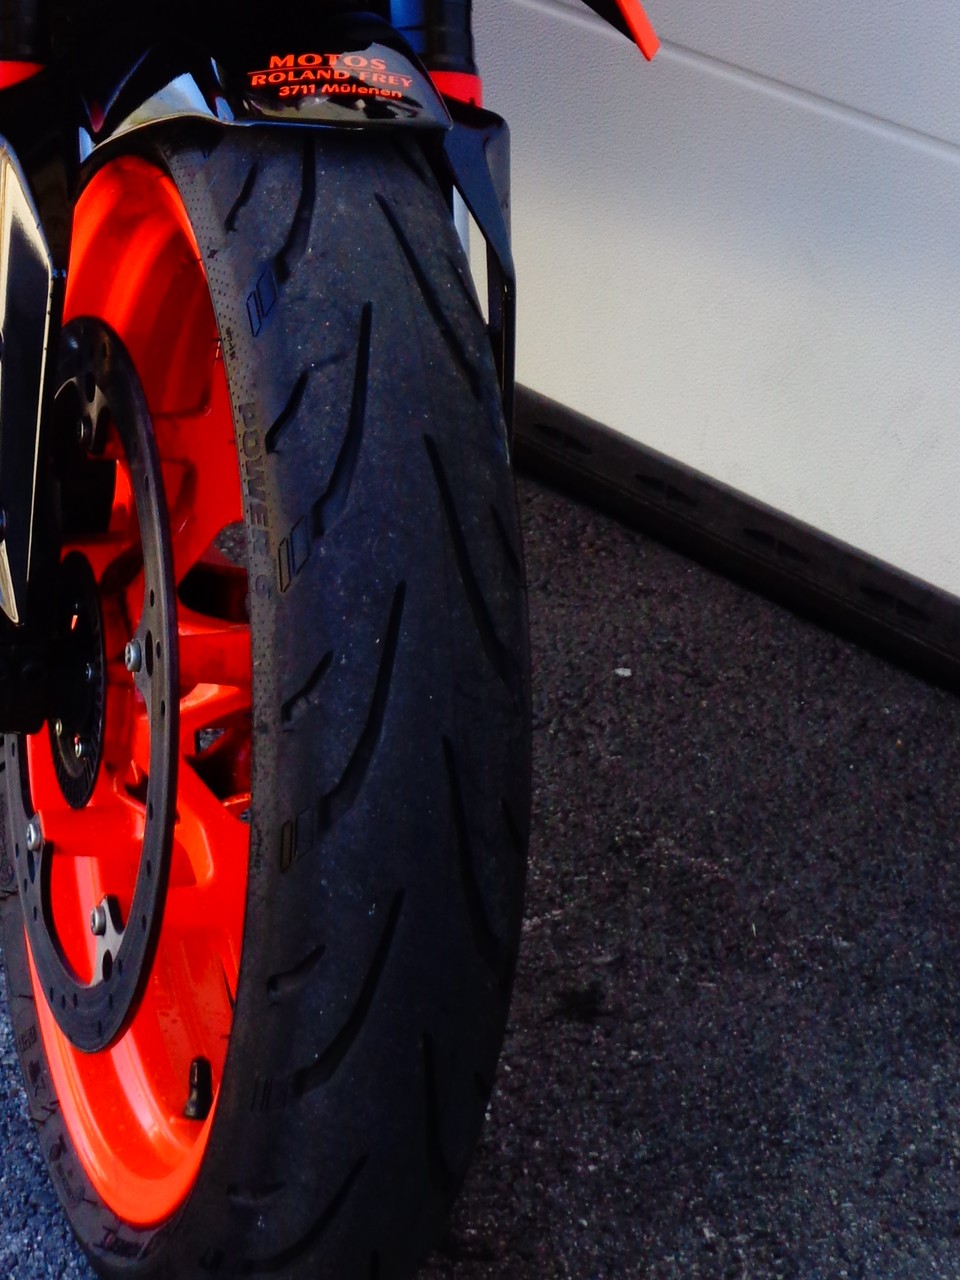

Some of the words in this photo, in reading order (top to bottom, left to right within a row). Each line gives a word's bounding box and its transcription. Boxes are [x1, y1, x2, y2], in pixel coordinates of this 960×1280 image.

[269, 53, 387, 70] MOTOS
[251, 69, 351, 86] ROLAND
[358, 71, 413, 88] FREY
[279, 84, 316, 96] 3711
[321, 83, 403, 98] Mülenen
